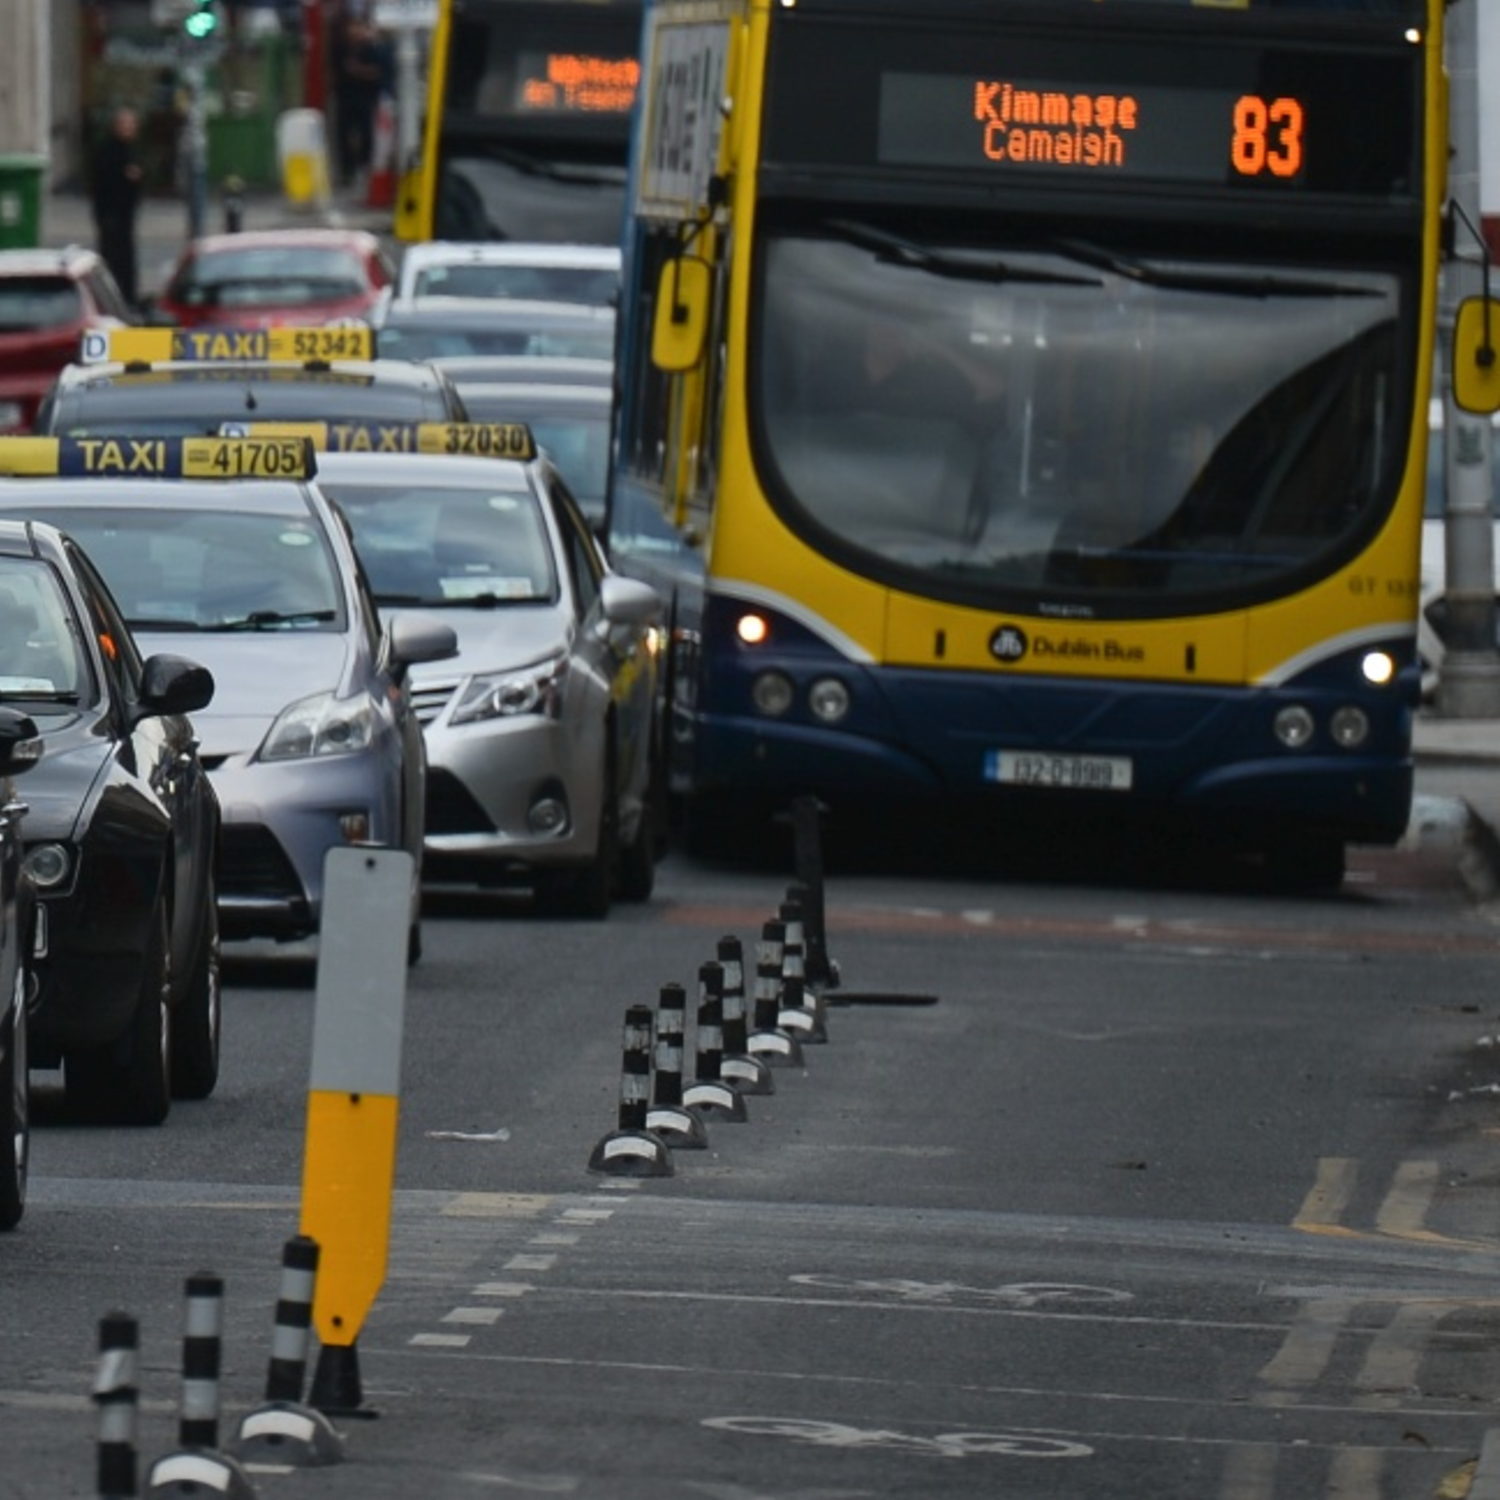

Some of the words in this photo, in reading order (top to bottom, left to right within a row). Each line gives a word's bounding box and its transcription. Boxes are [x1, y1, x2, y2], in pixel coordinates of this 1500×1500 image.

[974, 81, 1138, 130] Kimmage
[1231, 95, 1304, 176] 83
[84, 335, 106, 358] D
[191, 333, 266, 358] TAXI
[294, 332, 363, 357] 52342
[332, 425, 411, 452] TAXI
[445, 426, 524, 454] 32030
[77, 440, 165, 471] TAXI
[213, 443, 297, 473] 41705
[1033, 636, 1099, 658] Dublin
[1104, 639, 1145, 661] Bus
